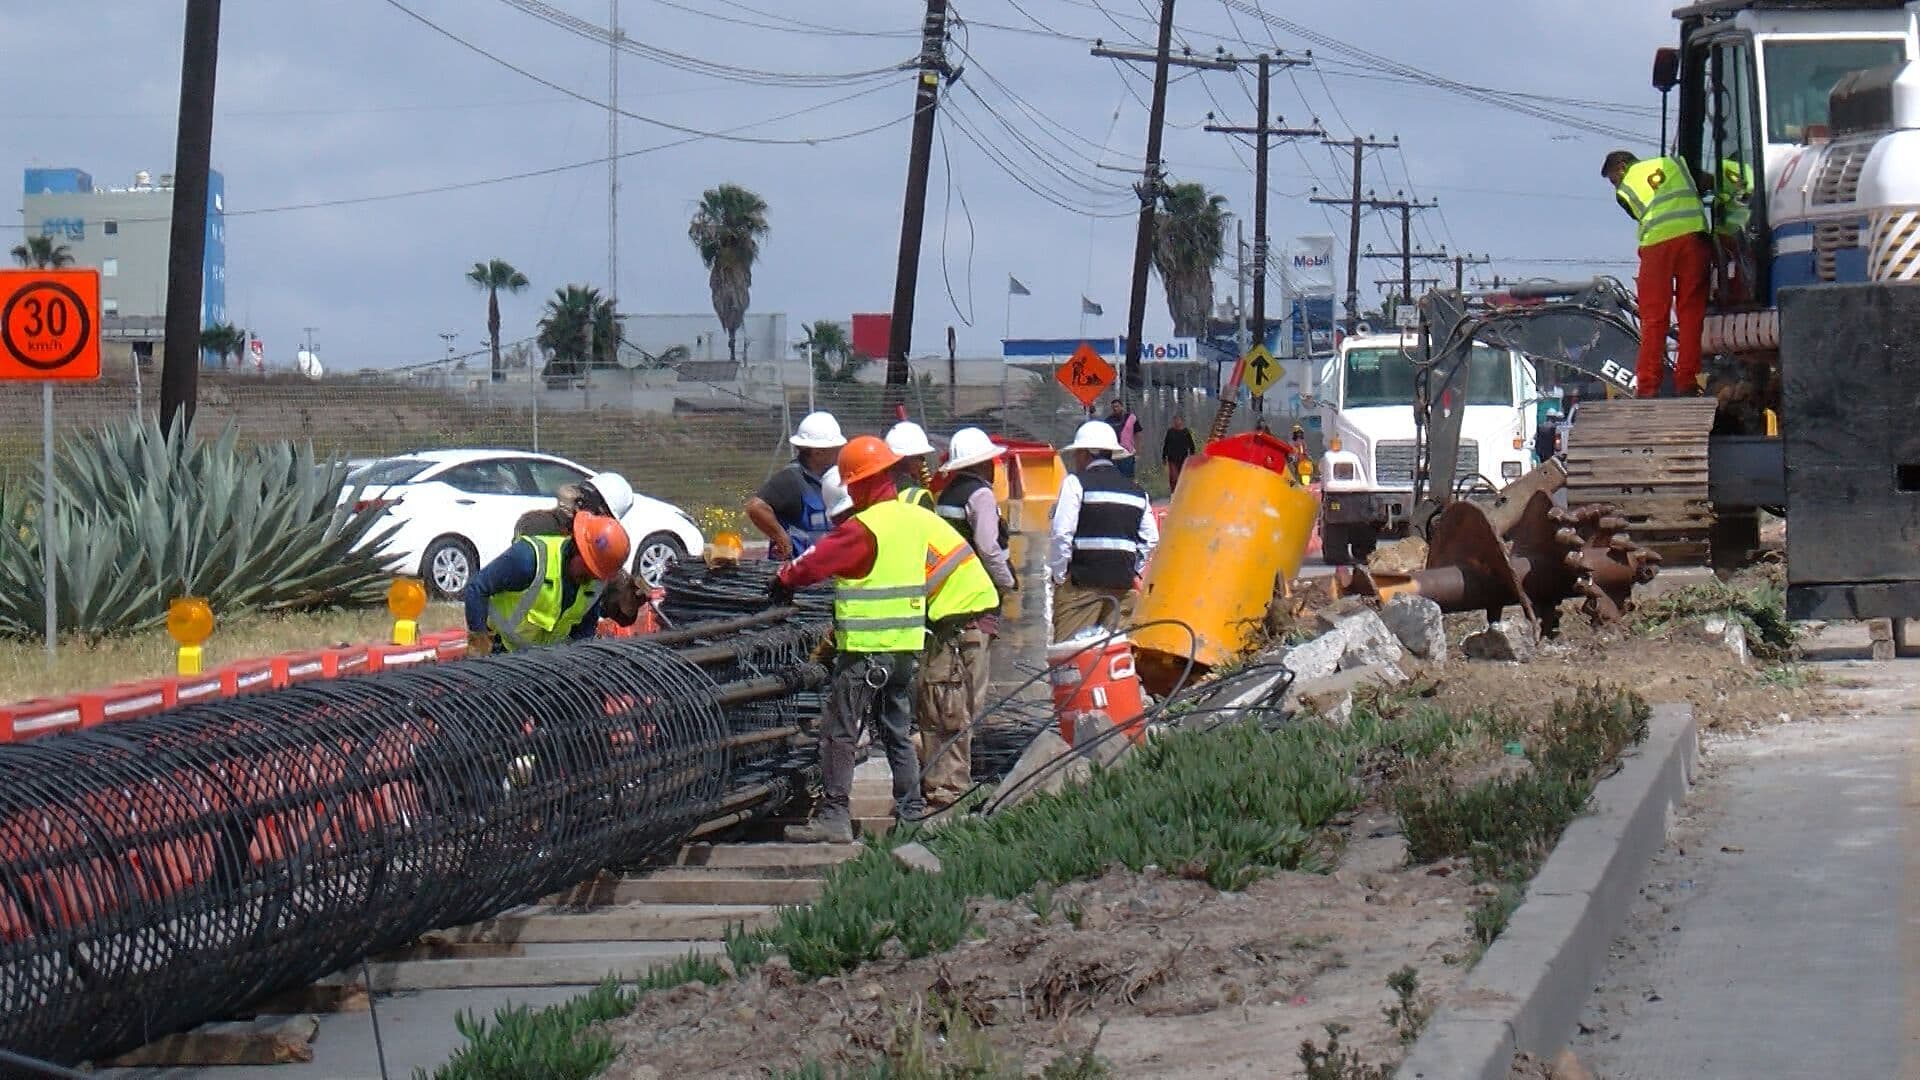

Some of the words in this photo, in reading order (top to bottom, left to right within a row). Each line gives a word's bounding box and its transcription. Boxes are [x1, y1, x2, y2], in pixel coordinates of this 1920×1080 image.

[1294, 255, 1330, 267] Mobil
[24, 297, 67, 337] 30
[28, 339, 63, 350] km/h
[1139, 343, 1189, 358] Mobil
